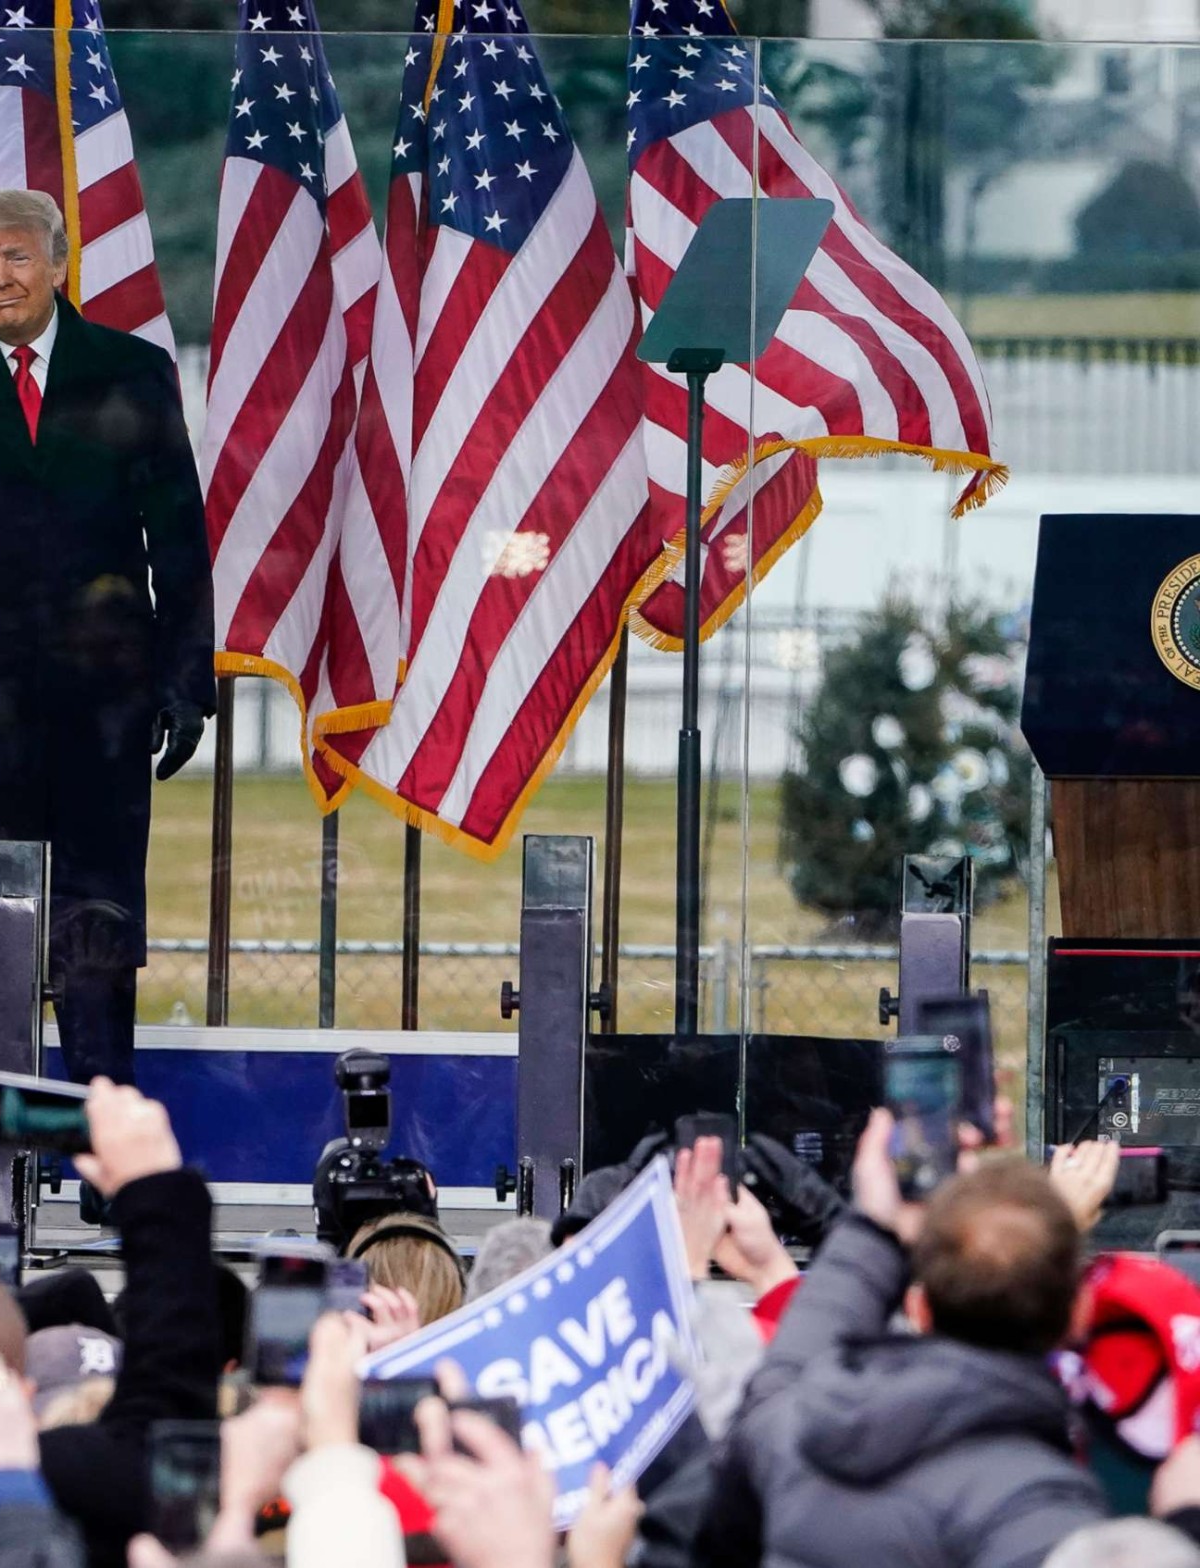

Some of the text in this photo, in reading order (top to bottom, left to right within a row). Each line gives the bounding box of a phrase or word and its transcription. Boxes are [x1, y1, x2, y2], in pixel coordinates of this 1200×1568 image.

[1157, 562, 1200, 619] PRESIDE
[1158, 625, 1170, 645] THE
[1165, 646, 1176, 660] OF
[476, 1276, 637, 1405] SAVE
